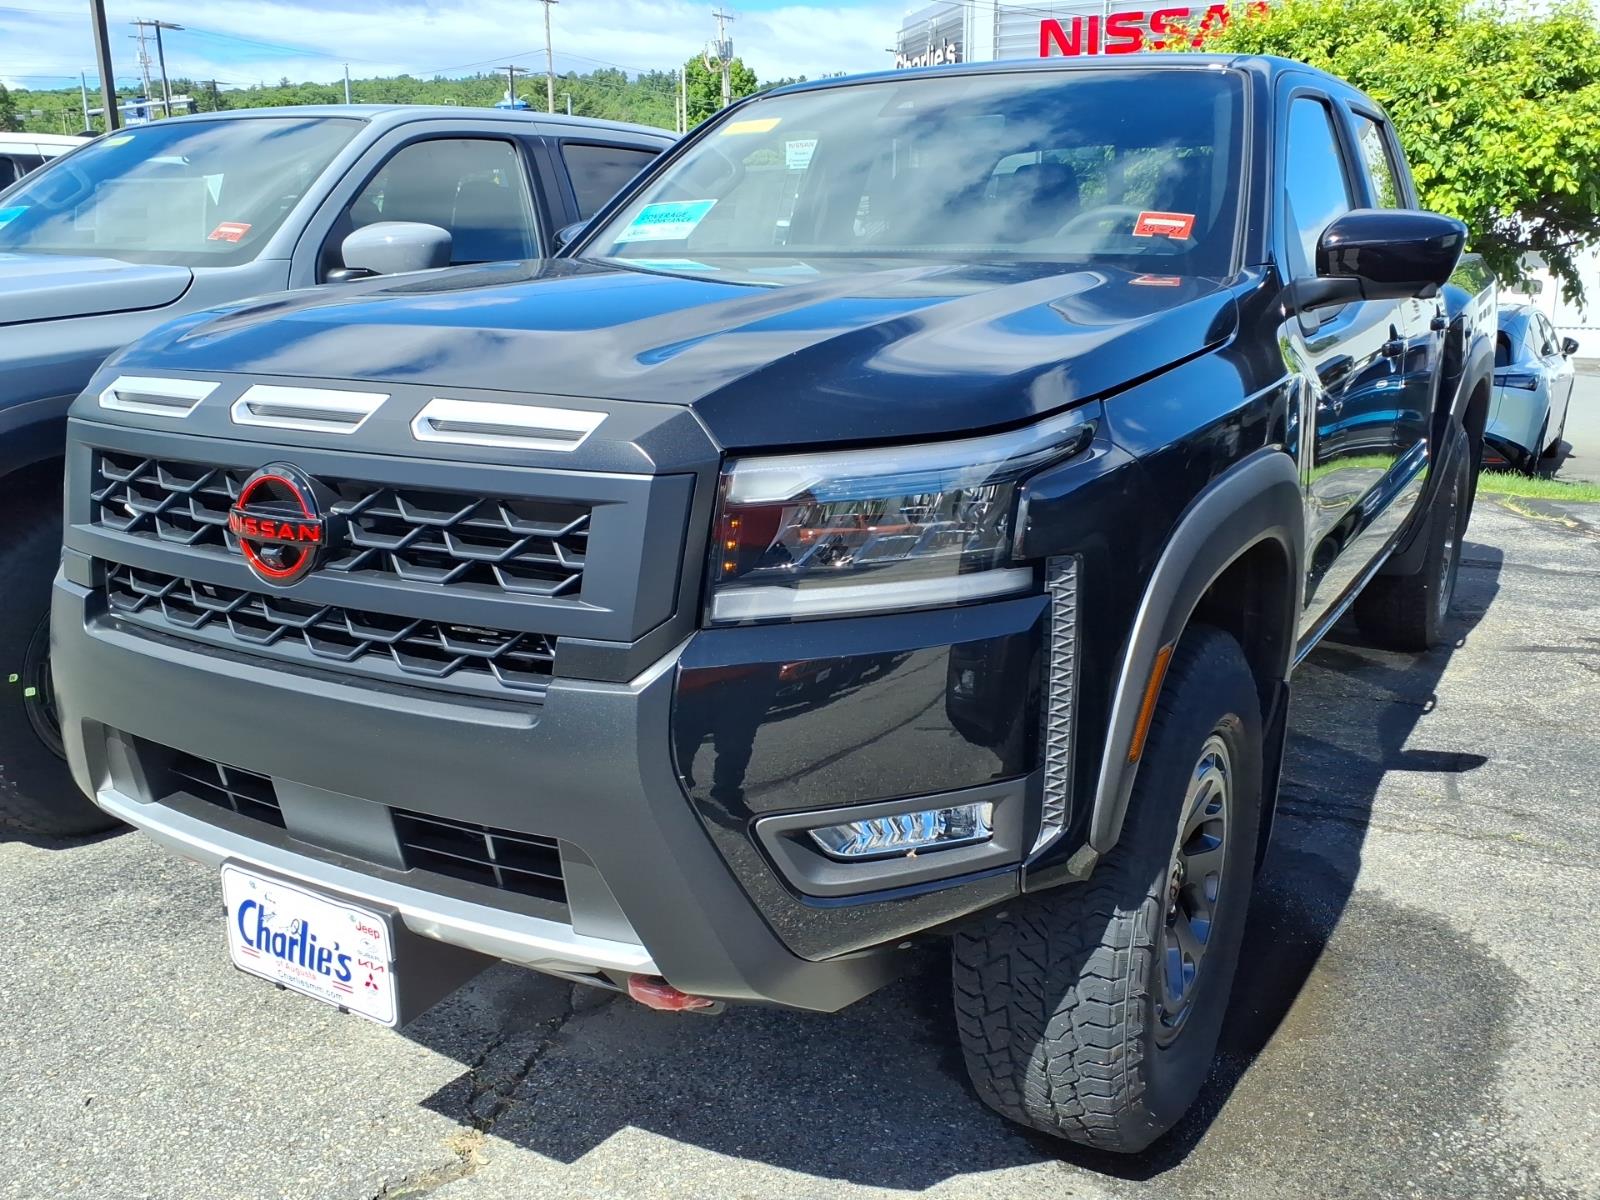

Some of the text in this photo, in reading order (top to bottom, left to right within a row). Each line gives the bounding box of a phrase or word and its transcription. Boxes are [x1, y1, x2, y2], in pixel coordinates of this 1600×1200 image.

[1039, 1, 1267, 58] NISSA
[228, 512, 321, 542] NISSAN
[238, 899, 352, 982] Charlie's
[355, 921, 381, 940] Jeep
